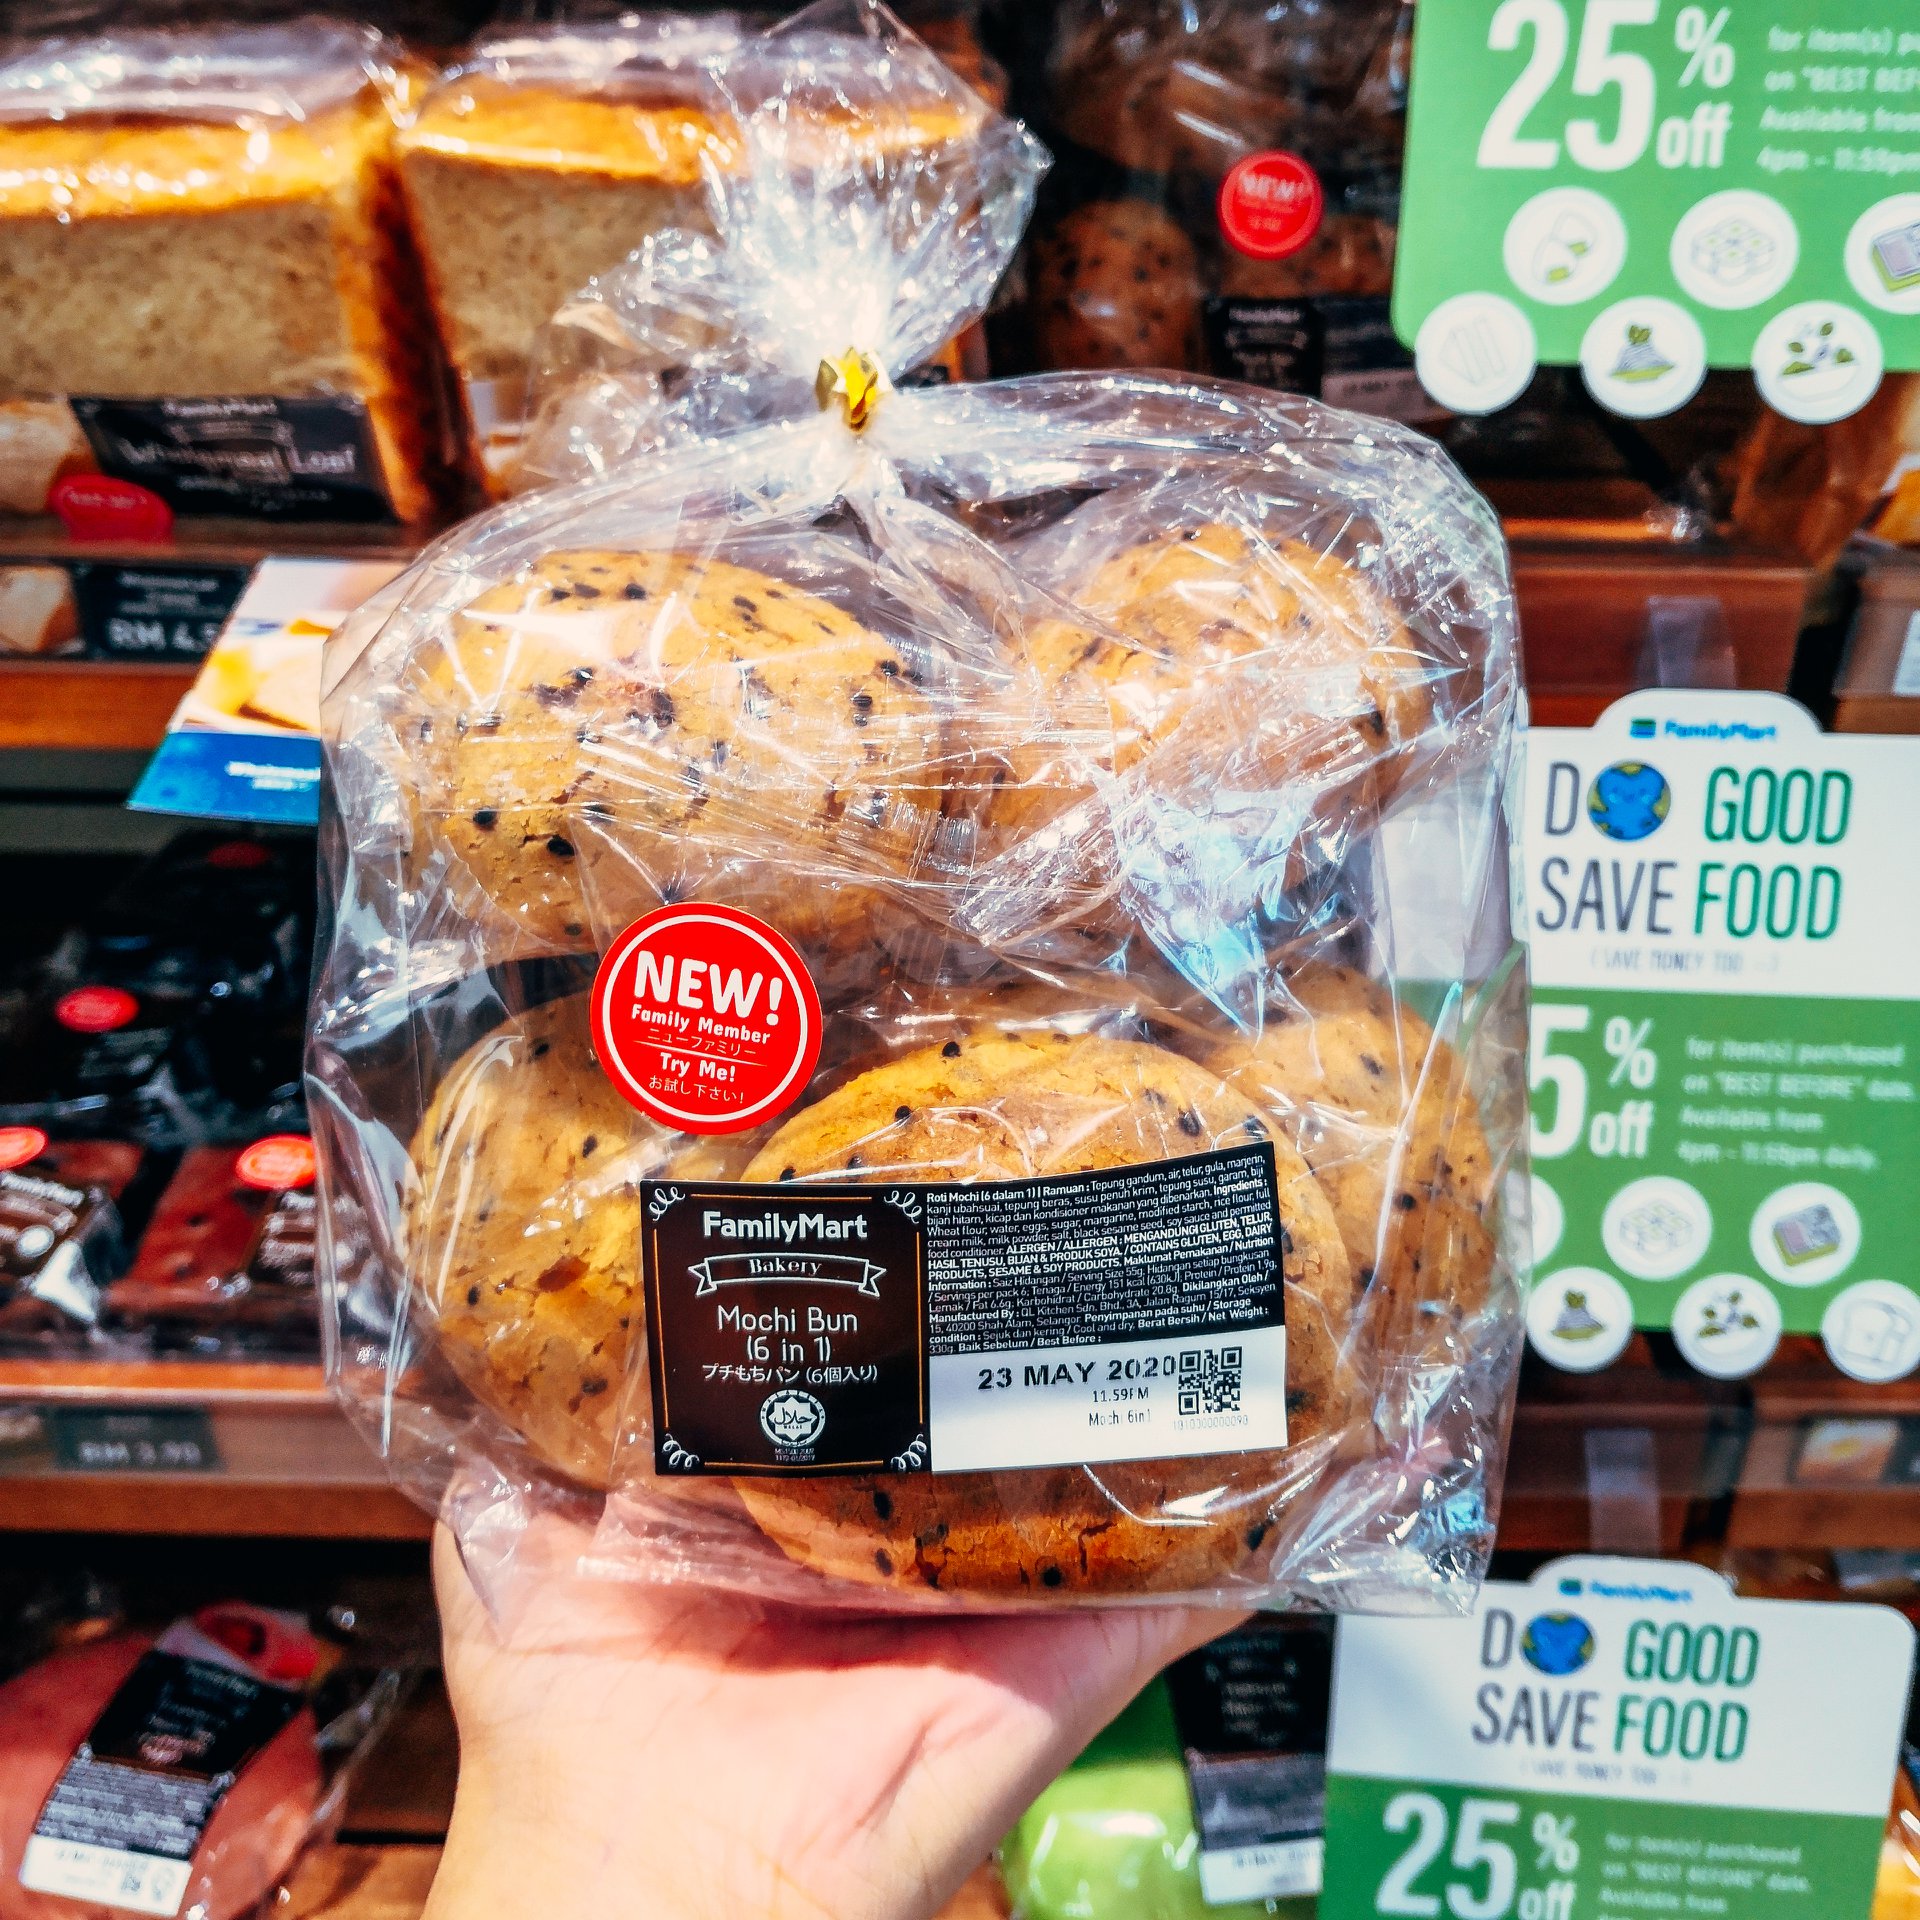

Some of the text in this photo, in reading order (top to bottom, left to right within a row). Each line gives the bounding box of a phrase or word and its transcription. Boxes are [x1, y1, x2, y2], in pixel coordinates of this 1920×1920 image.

[1759, 104, 1868, 132] Available
[1655, 101, 1733, 169] off
[1704, 766, 1853, 846] GOOD
[1536, 856, 1841, 939] SAVE FOOD
[634, 950, 782, 1025] NEW!
[632, 1004, 770, 1044] Family Member
[648, 1028, 756, 1056] ニューファミリー
[660, 1052, 735, 1082] Try Me!
[1590, 1100, 1654, 1158] off
[926, 1192, 946, 1202] Roti
[949, 1190, 978, 1202] Mochi
[980, 1190, 990, 1202] (6
[992, 1187, 1023, 1199] dalam
[1026, 1186, 1035, 1199] 1)
[1043, 1181, 1084, 1196] Ramuan
[1090, 1176, 1124, 1192] Tepung
[926, 1203, 950, 1216] kanji
[1004, 1198, 1038, 1212] tepung
[1074, 1193, 1097, 1204] susu
[1100, 1187, 1130, 1203] penuh
[985, 1211, 1010, 1225] kicap
[1090, 1198, 1134, 1213] makanan
[1136, 1197, 1158, 1210] yang
[1214, 1176, 1262, 1198] Ingredients
[703, 1211, 867, 1242] FamilyMart
[927, 1225, 959, 1236] Wheat
[1073, 1211, 1209, 1237] black sauce
[928, 1258, 958, 1270] HASIL
[1050, 1248, 1092, 1262] PRODUK
[1130, 1237, 1179, 1254] CONTAINS
[1245, 1222, 1271, 1237] DAIRY
[988, 1264, 1031, 1277] SESAME
[1043, 1261, 1062, 1273] SOY
[1124, 1249, 1171, 1265] Maklumat
[1173, 1241, 1228, 1260] Pemakanan
[1235, 1234, 1273, 1251] Nutrition
[1006, 1240, 1055, 1254] ALERGEN
[1062, 1234, 1116, 1250] ALLERGEN
[750, 1257, 822, 1276] Bakery
[928, 1245, 1269, 1292] Information setiap bungkusan
[1241, 1270, 1262, 1284] Oleh
[1108, 1277, 1123, 1288] 151
[718, 1305, 858, 1332] Mochi Bun
[929, 1303, 1073, 1323] Manufactured By Kitchen
[929, 1303, 1263, 1344] condition Berat Bersih Net Weight
[1084, 1294, 1251, 1324] Penyimpanan pada suhu Storage
[747, 1336, 831, 1361] (6 in 1)
[958, 1332, 1095, 1352] Baik Sebelum Best Before
[978, 1355, 1176, 1390] 23 MAY 2020
[1624, 1619, 1760, 1688] GOOD
[1471, 1682, 1749, 1762] SAVE FOOD
[1517, 1879, 1577, 1920] off
